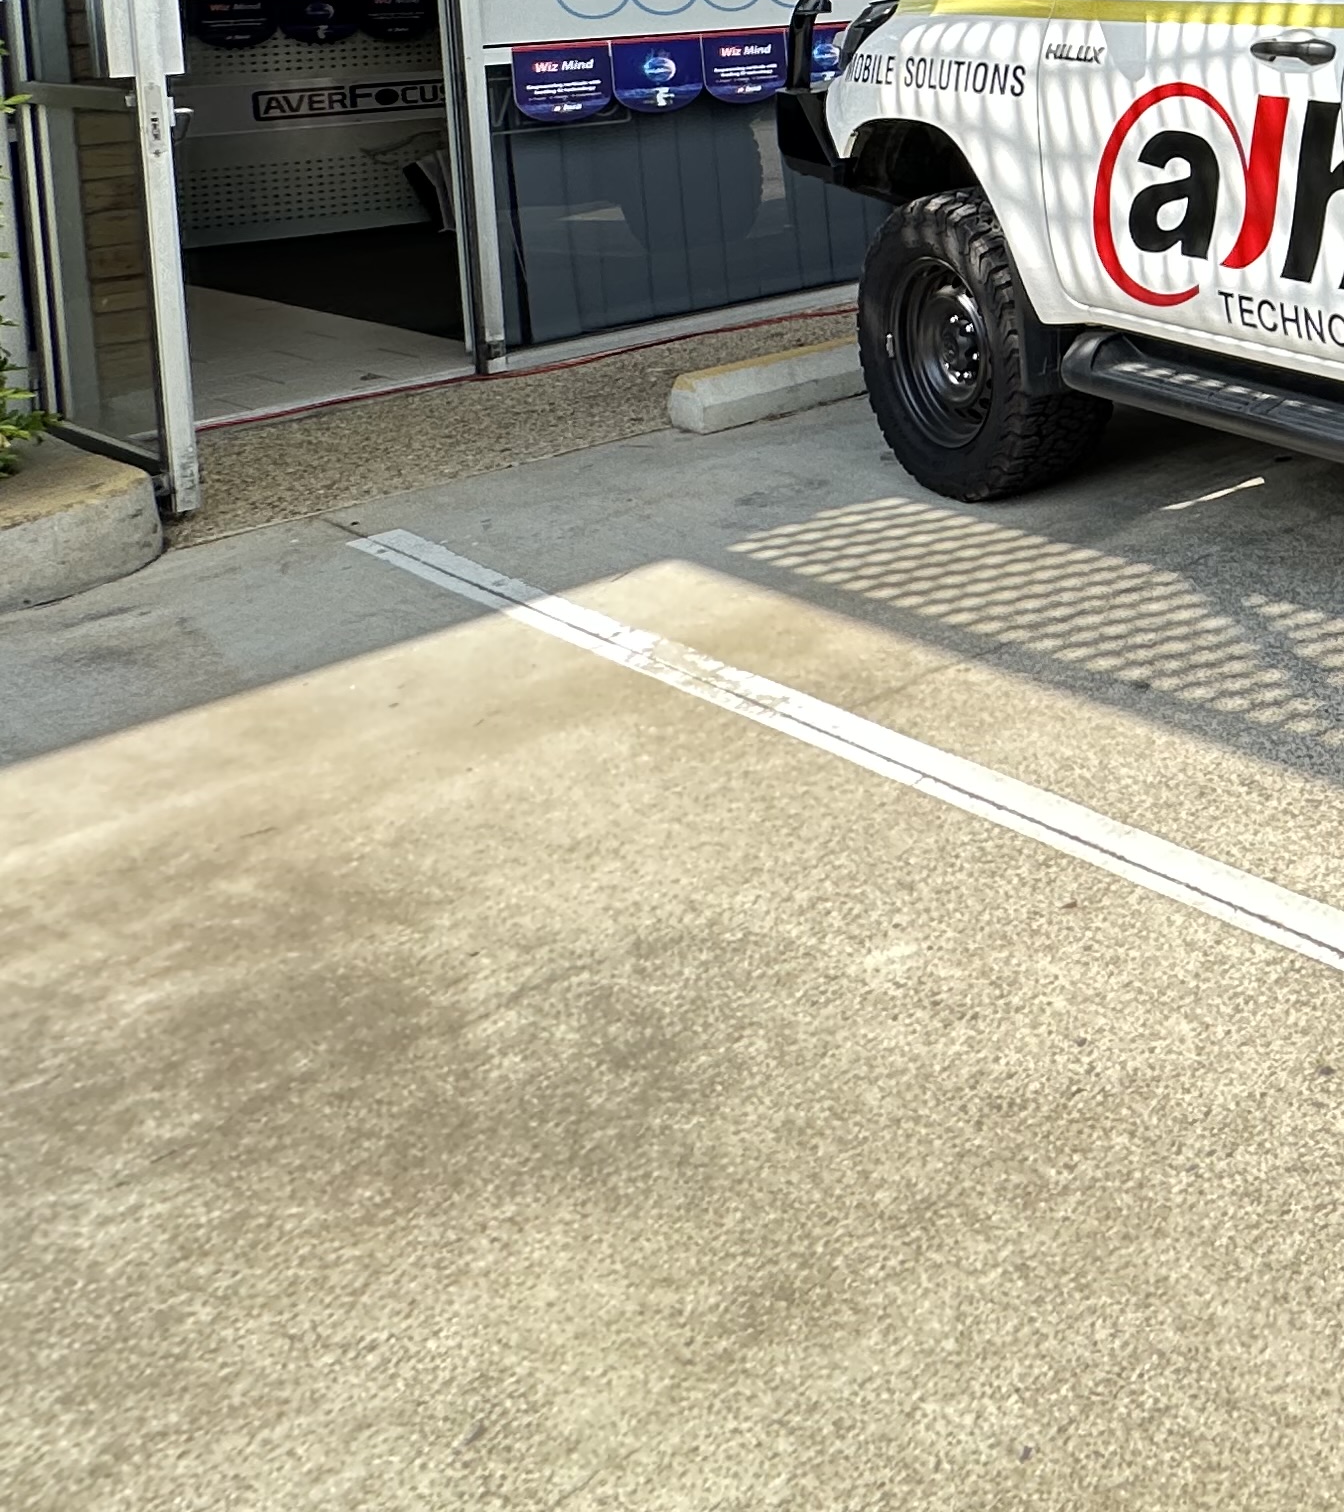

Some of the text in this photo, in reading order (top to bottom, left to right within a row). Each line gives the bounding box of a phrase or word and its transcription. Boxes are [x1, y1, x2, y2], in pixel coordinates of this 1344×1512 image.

[719, 43, 772, 58] Wiz Mind
[534, 58, 595, 73] Wiz Mind
[904, 56, 1026, 97] SOLUTIONS
